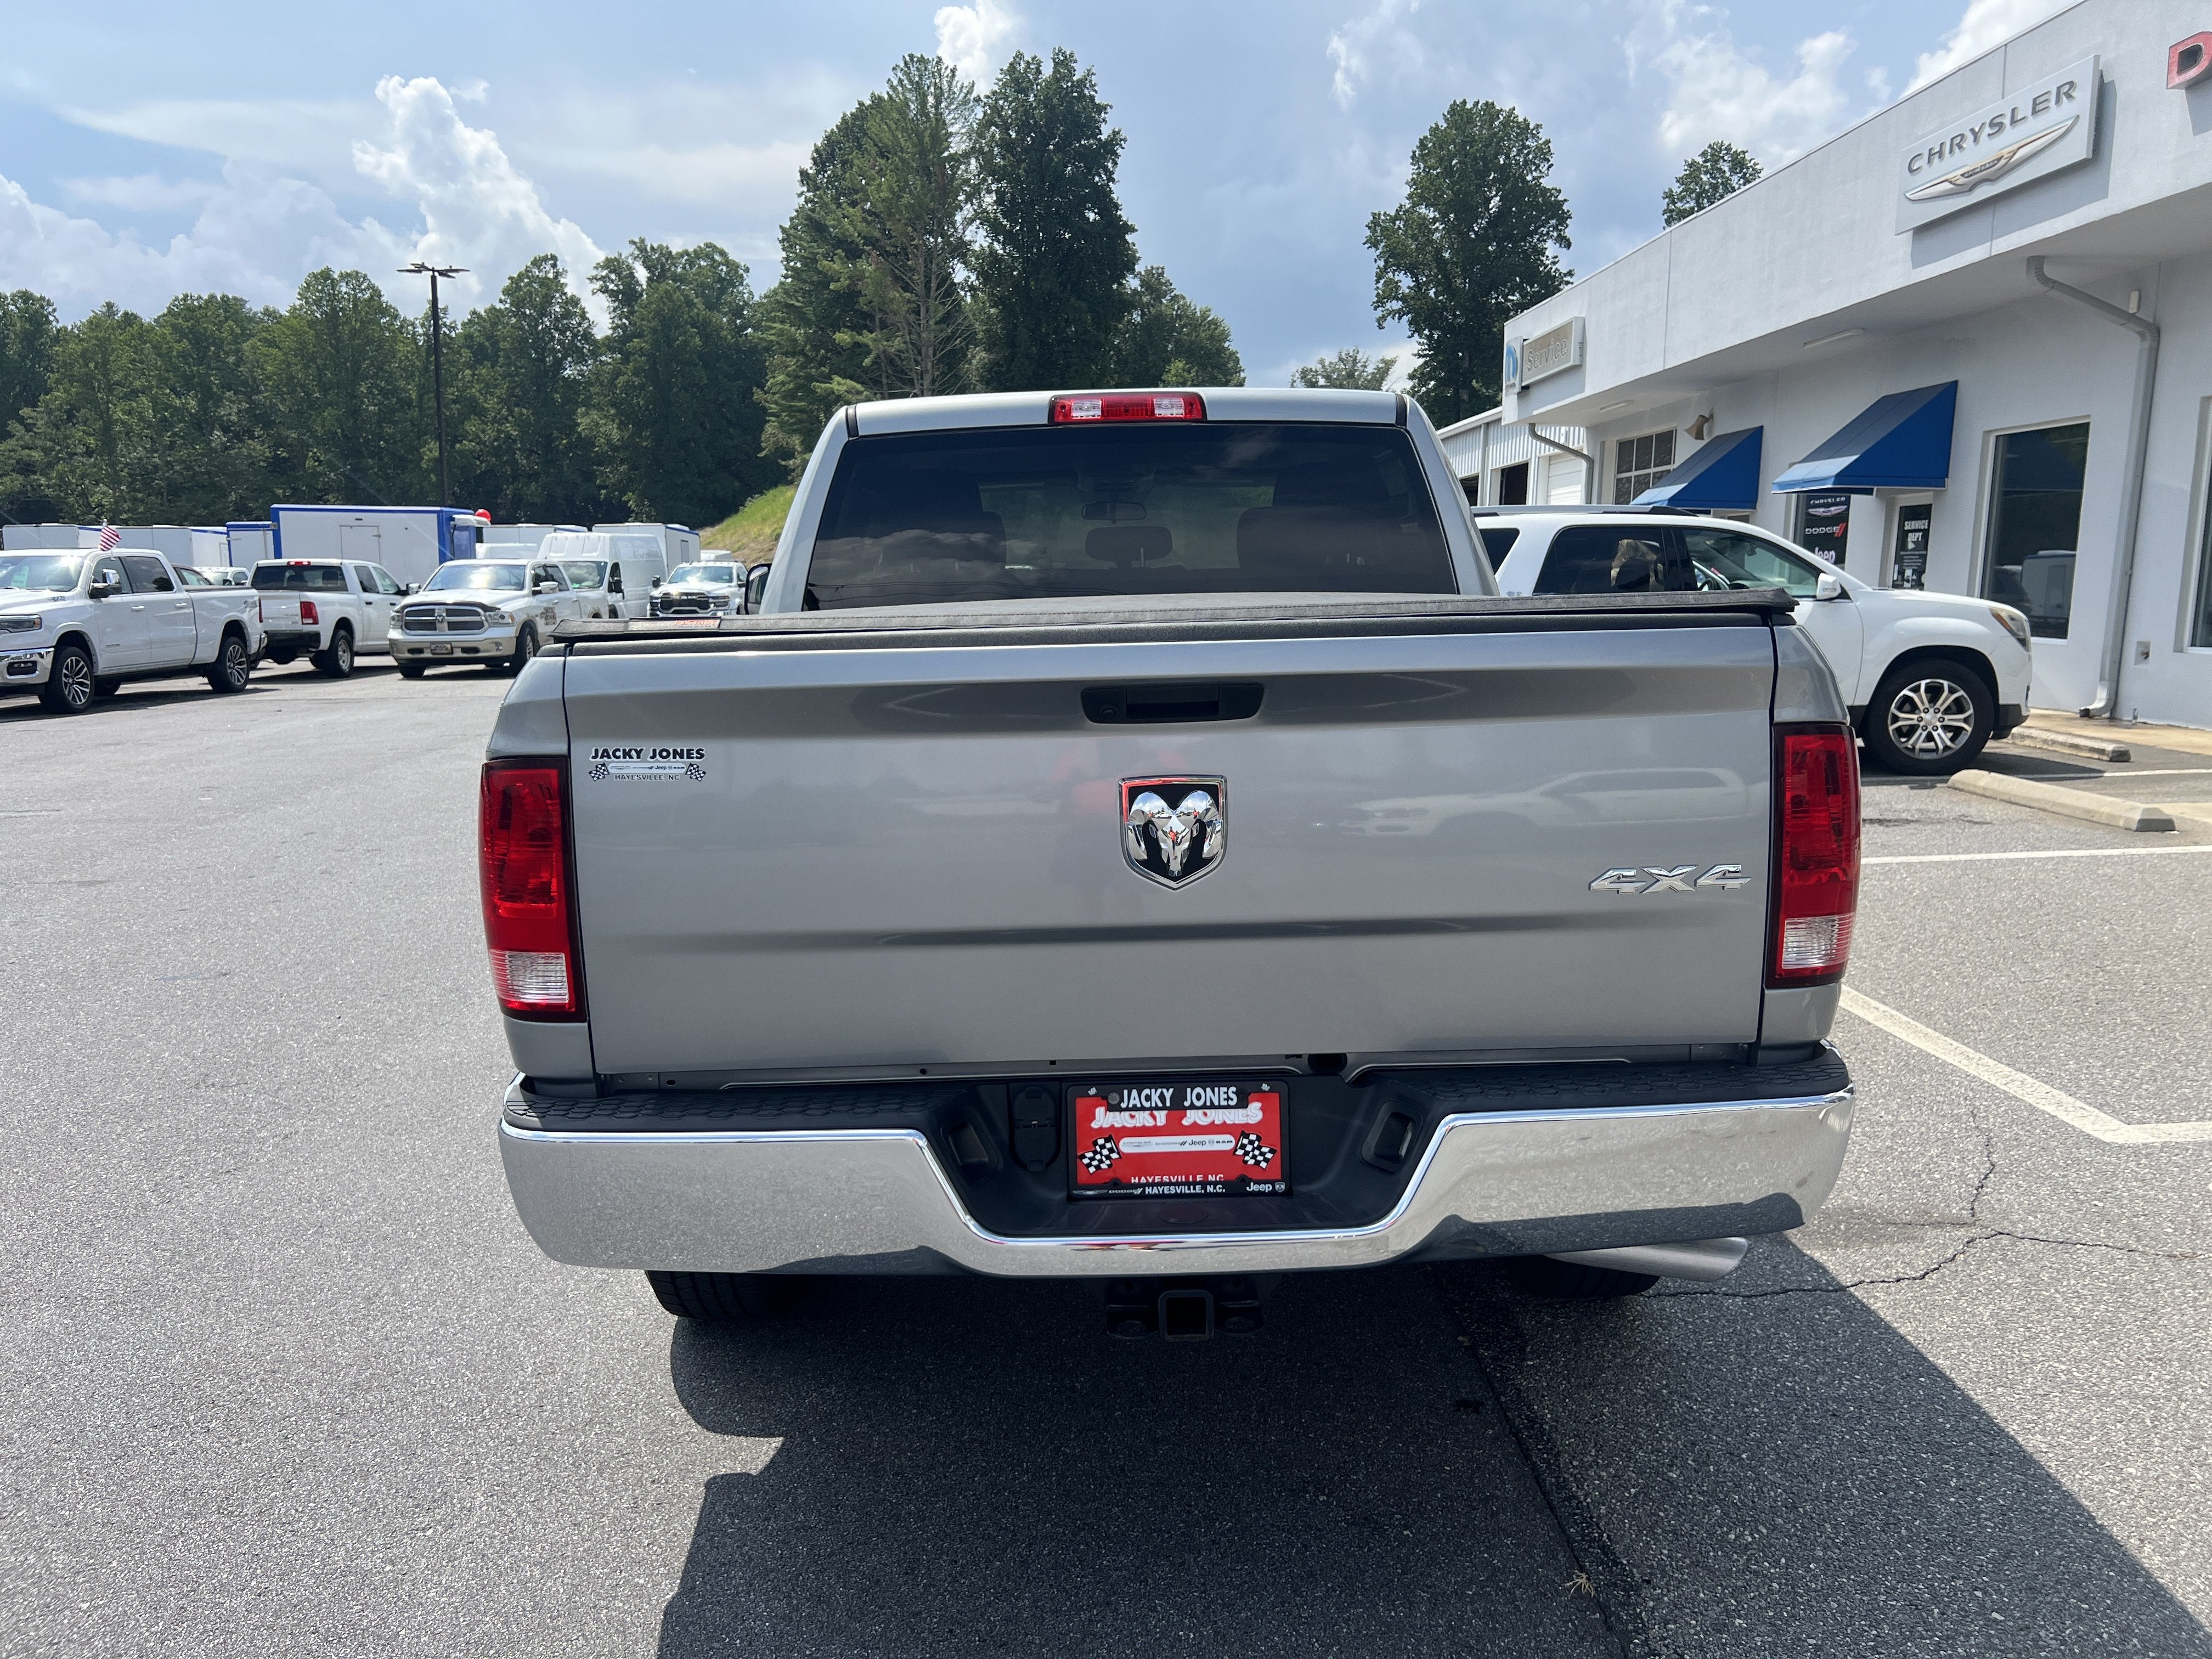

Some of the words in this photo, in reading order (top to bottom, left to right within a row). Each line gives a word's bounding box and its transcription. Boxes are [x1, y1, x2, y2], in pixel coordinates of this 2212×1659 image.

[1908, 80, 2076, 174] CHRYSLER
[1527, 338, 1567, 371] Service
[1805, 526, 1840, 535] DODGE
[1904, 520, 1929, 531] SERVICE
[1908, 532, 1923, 541] DEPT
[591, 748, 644, 760] JACKY
[649, 748, 705, 760] JONES
[1120, 1088, 1174, 1108] JACKY
[1183, 1086, 1238, 1107] JONES
[1091, 1106, 1168, 1128] JACKY
[1182, 1102, 1263, 1125] JONES
[1207, 1184, 1226, 1193] N.C.
[1246, 1182, 1272, 1193] Jeep
